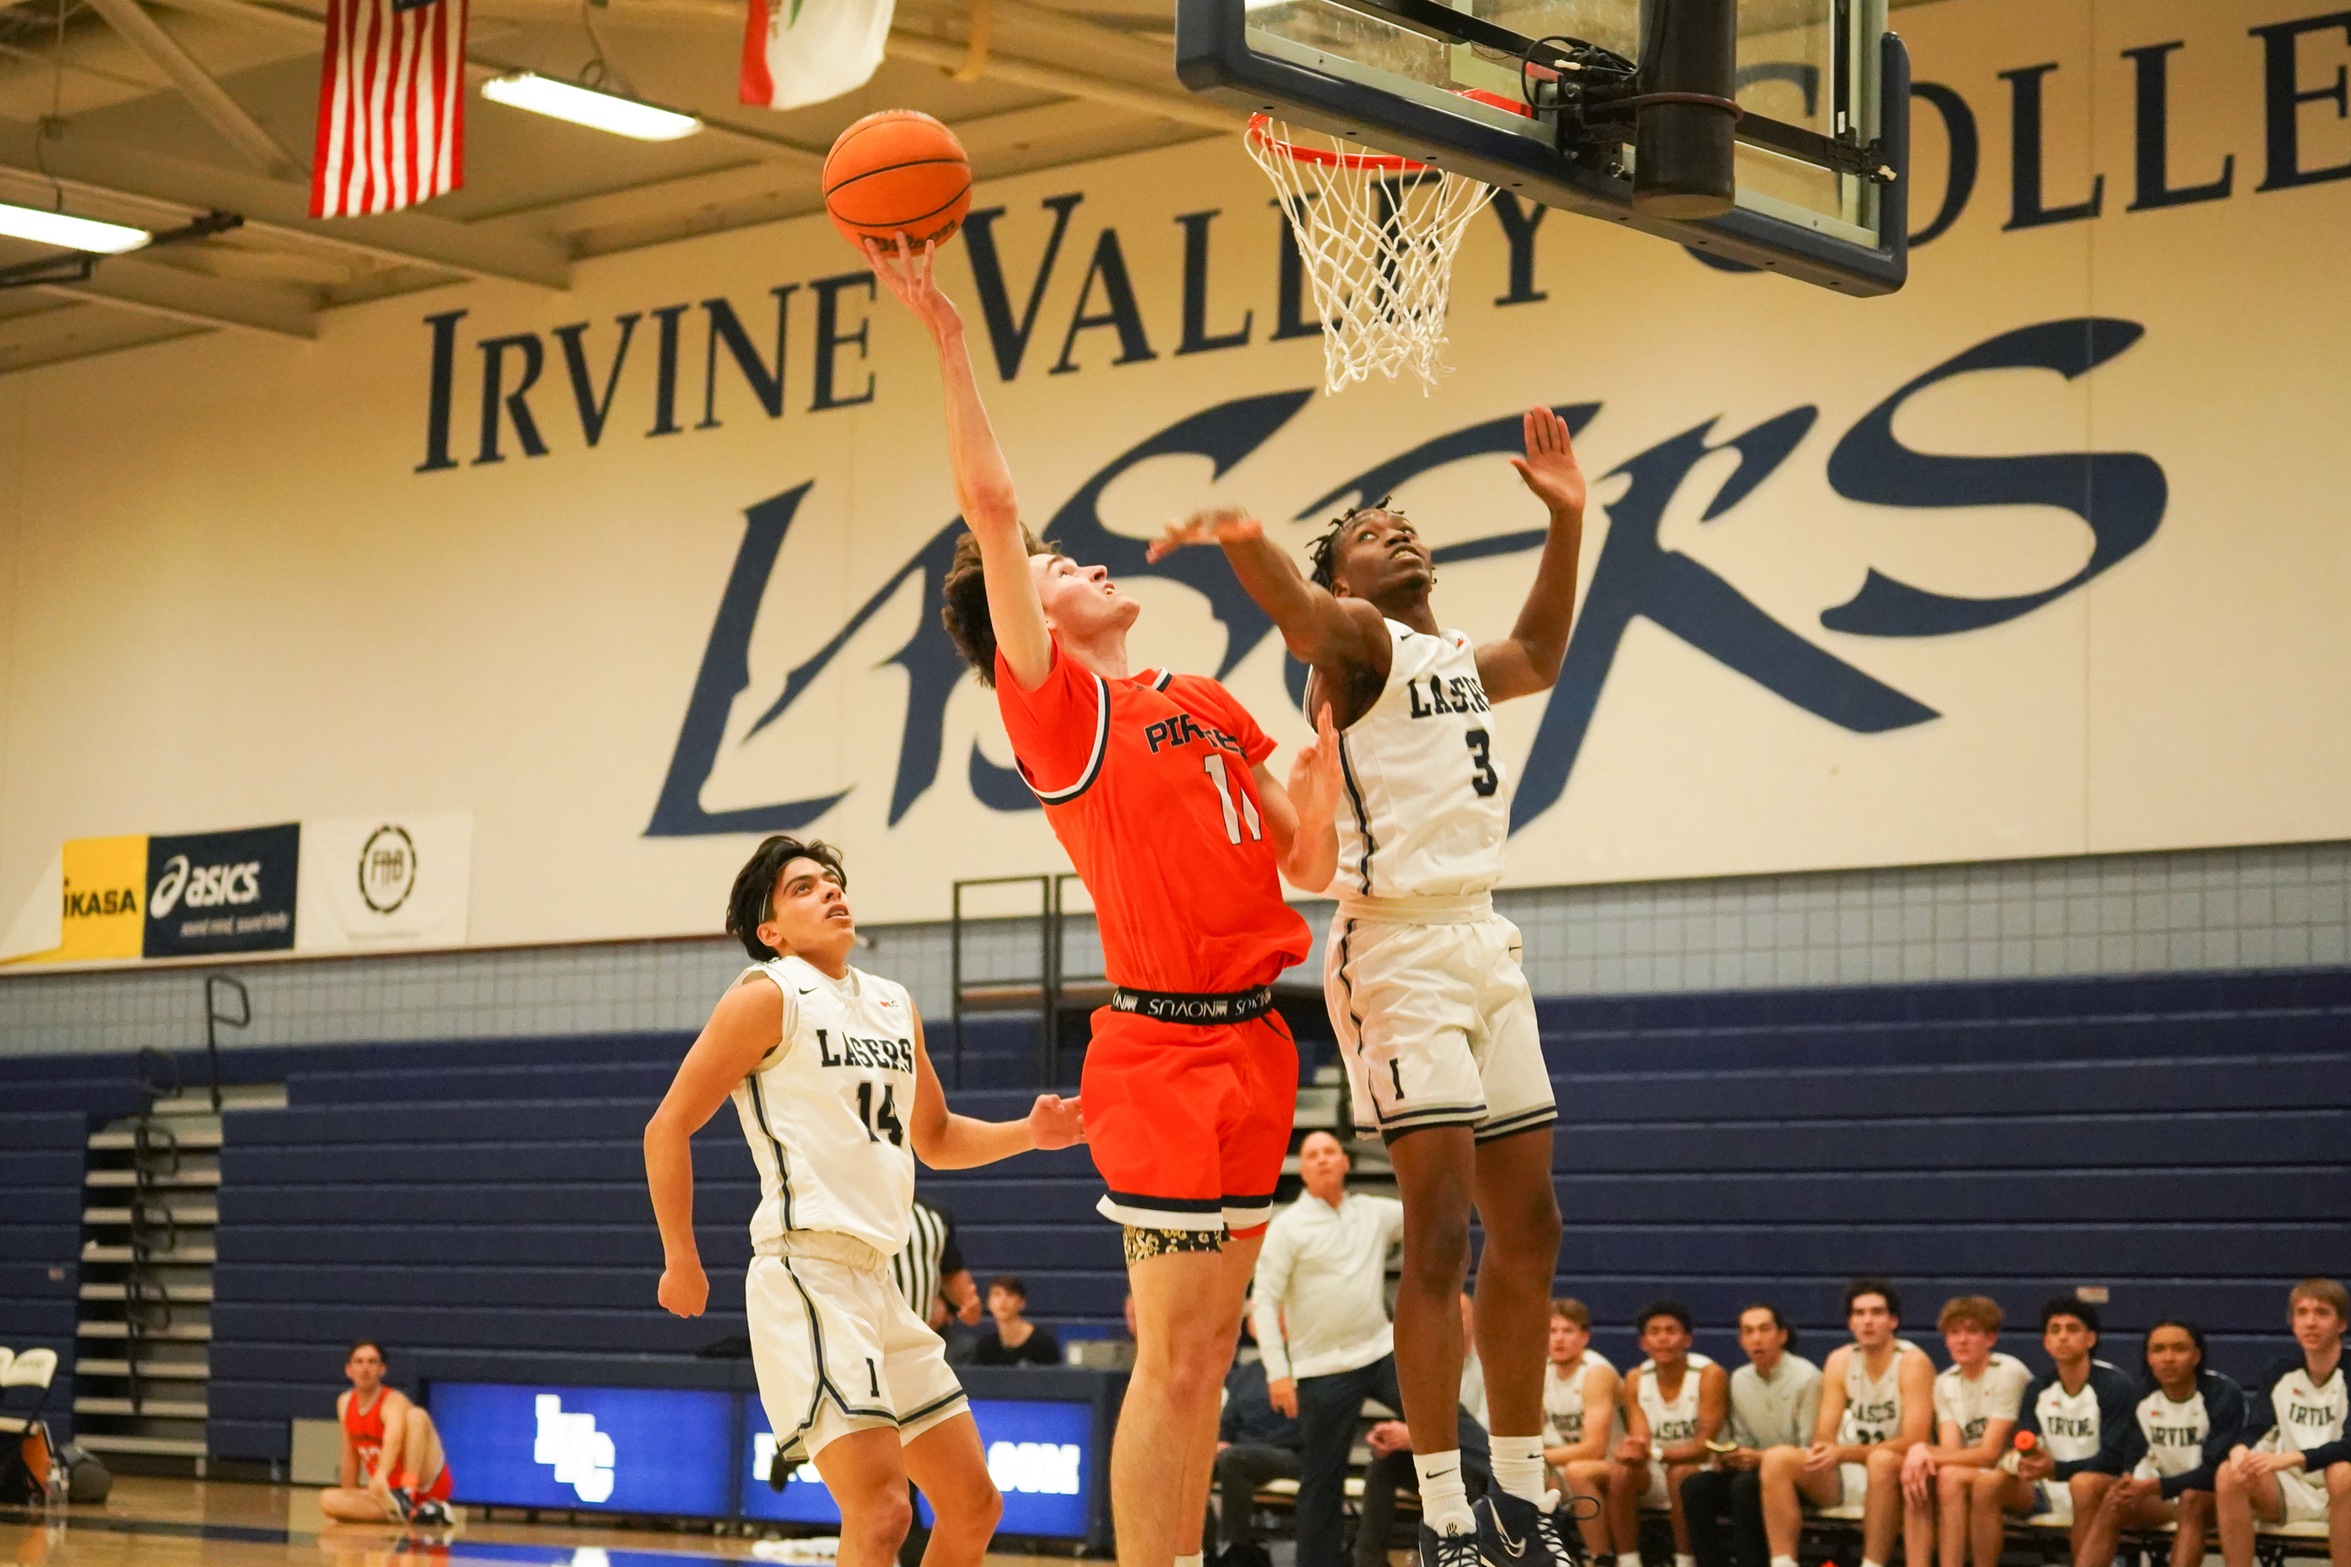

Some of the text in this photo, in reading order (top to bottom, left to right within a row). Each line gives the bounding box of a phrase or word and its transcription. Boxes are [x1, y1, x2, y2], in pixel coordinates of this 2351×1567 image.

[414, 270, 877, 474] IRVINE
[961, 164, 1548, 383] VALLEY
[1465, 729, 1498, 796] 3
[1203, 754, 1262, 845] 11
[1148, 999, 1216, 1018] NOVUS
[816, 1029, 913, 1075] LASERS
[856, 1081, 904, 1147] 14
